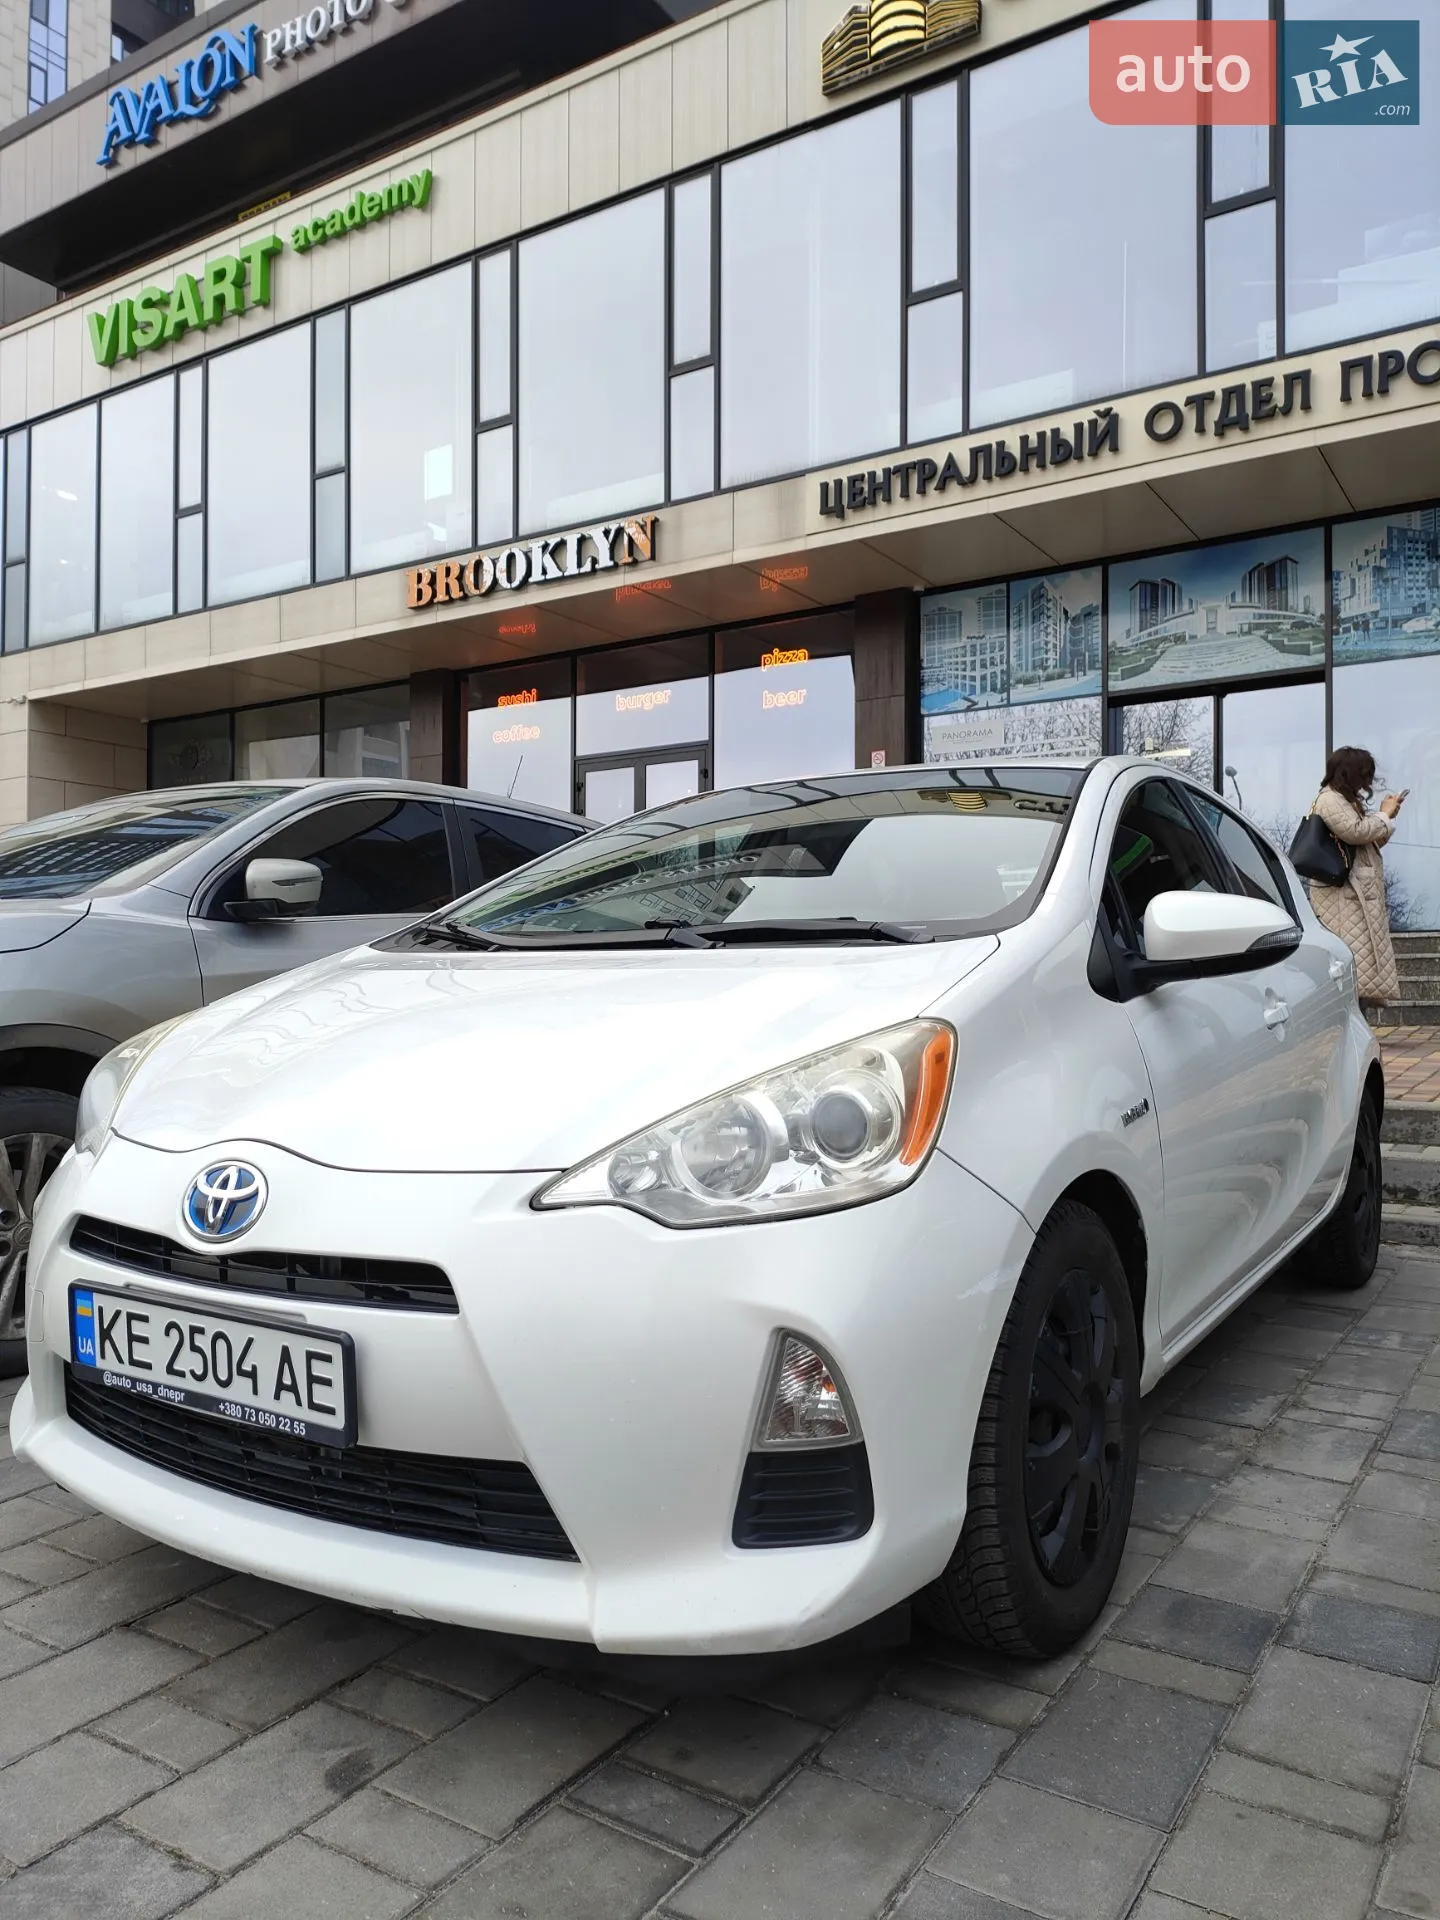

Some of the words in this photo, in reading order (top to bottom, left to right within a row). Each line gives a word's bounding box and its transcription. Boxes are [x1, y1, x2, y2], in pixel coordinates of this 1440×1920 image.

[96, 23, 259, 166] AVALON
[263, 0, 374, 65] PHOTO
[86, 234, 283, 367] VISART
[290, 168, 433, 254] academy
[819, 407, 1119, 519] ЦЕНТРАЛЬНЫЙ
[1144, 368, 1312, 443] ОТДЕЛ
[405, 514, 658, 609] BROOKLYN
[761, 648, 809, 672] pizza
[497, 688, 537, 709] sushi
[615, 689, 672, 712] burger
[762, 688, 807, 709] beer
[492, 724, 541, 744] coffee
[942, 728, 993, 741] PANORAMA
[78, 1335, 95, 1356] UA
[97, 1304, 153, 1371] KE
[164, 1320, 259, 1396] 2504
[273, 1344, 337, 1416] AE
[103, 1371, 185, 1403] @auto_usa_dnepr
[219, 1401, 242, 1419] +380
[245, 1407, 256, 1422] 73
[258, 1412, 277, 1428] 050
[279, 1417, 291, 1433] 22
[293, 1423, 306, 1437] 55
